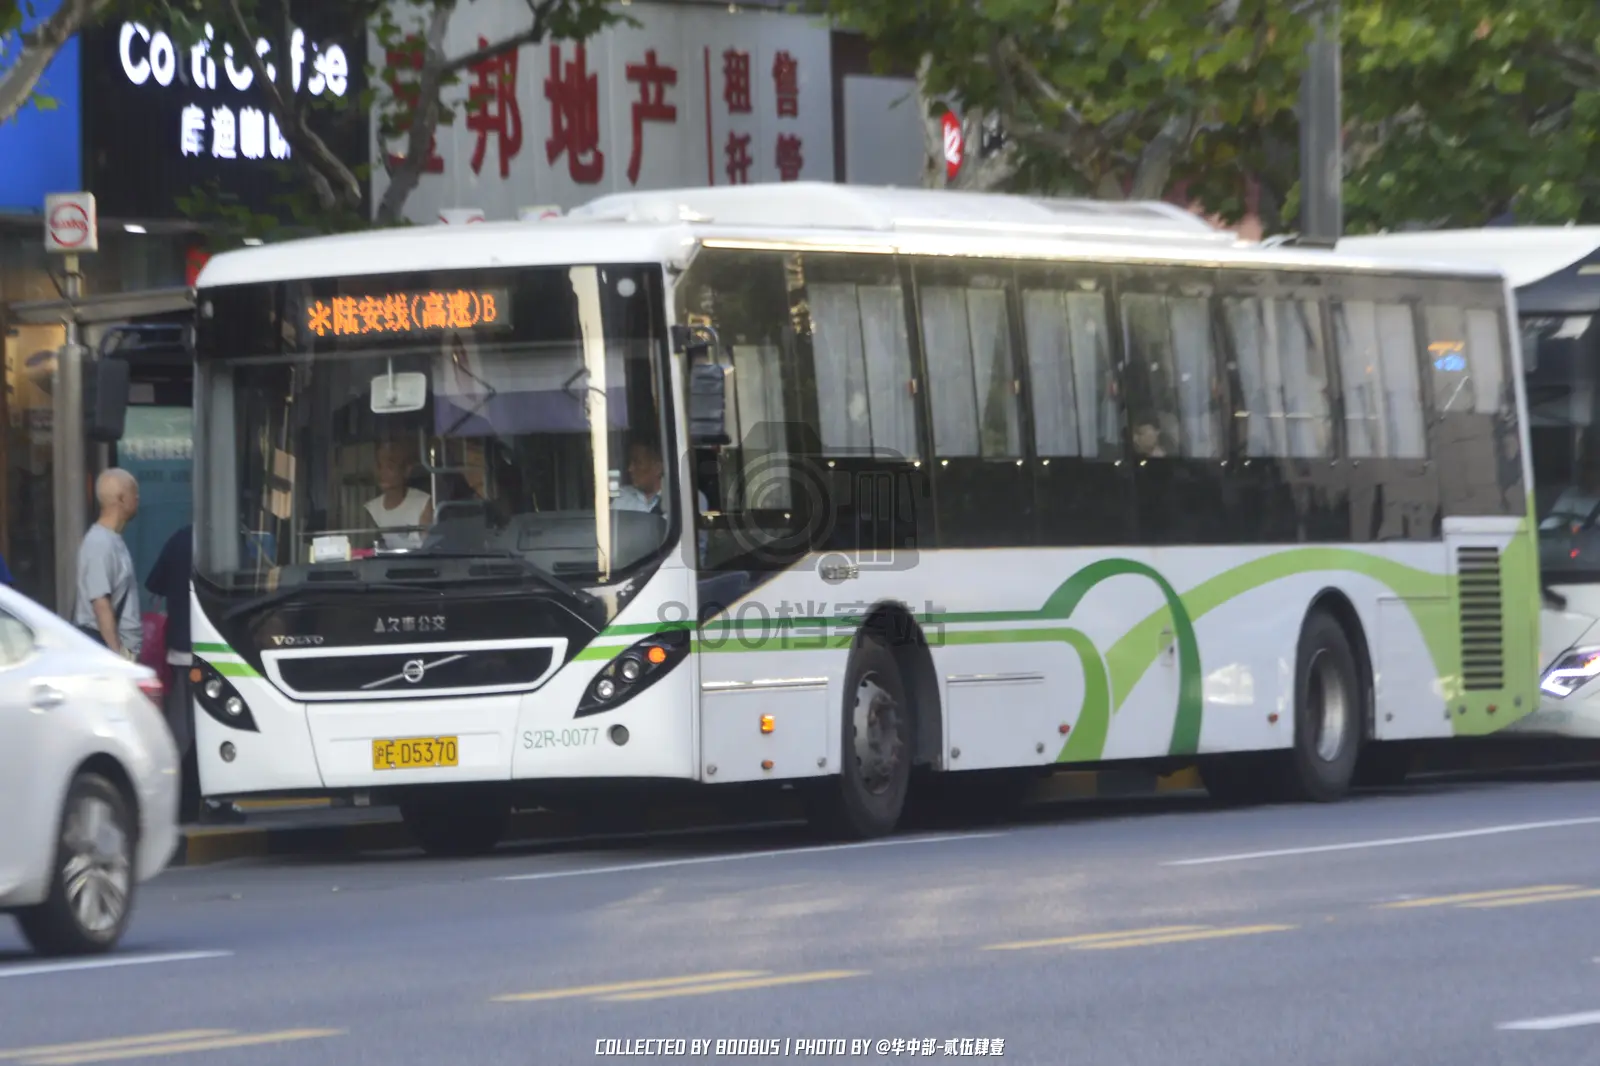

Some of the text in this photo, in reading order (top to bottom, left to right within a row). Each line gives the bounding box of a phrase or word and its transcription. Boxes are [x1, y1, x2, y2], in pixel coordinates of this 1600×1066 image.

[119, 20, 217, 90] Coti
[271, 635, 324, 646] VOLVO
[523, 727, 600, 750] S2R-0077
